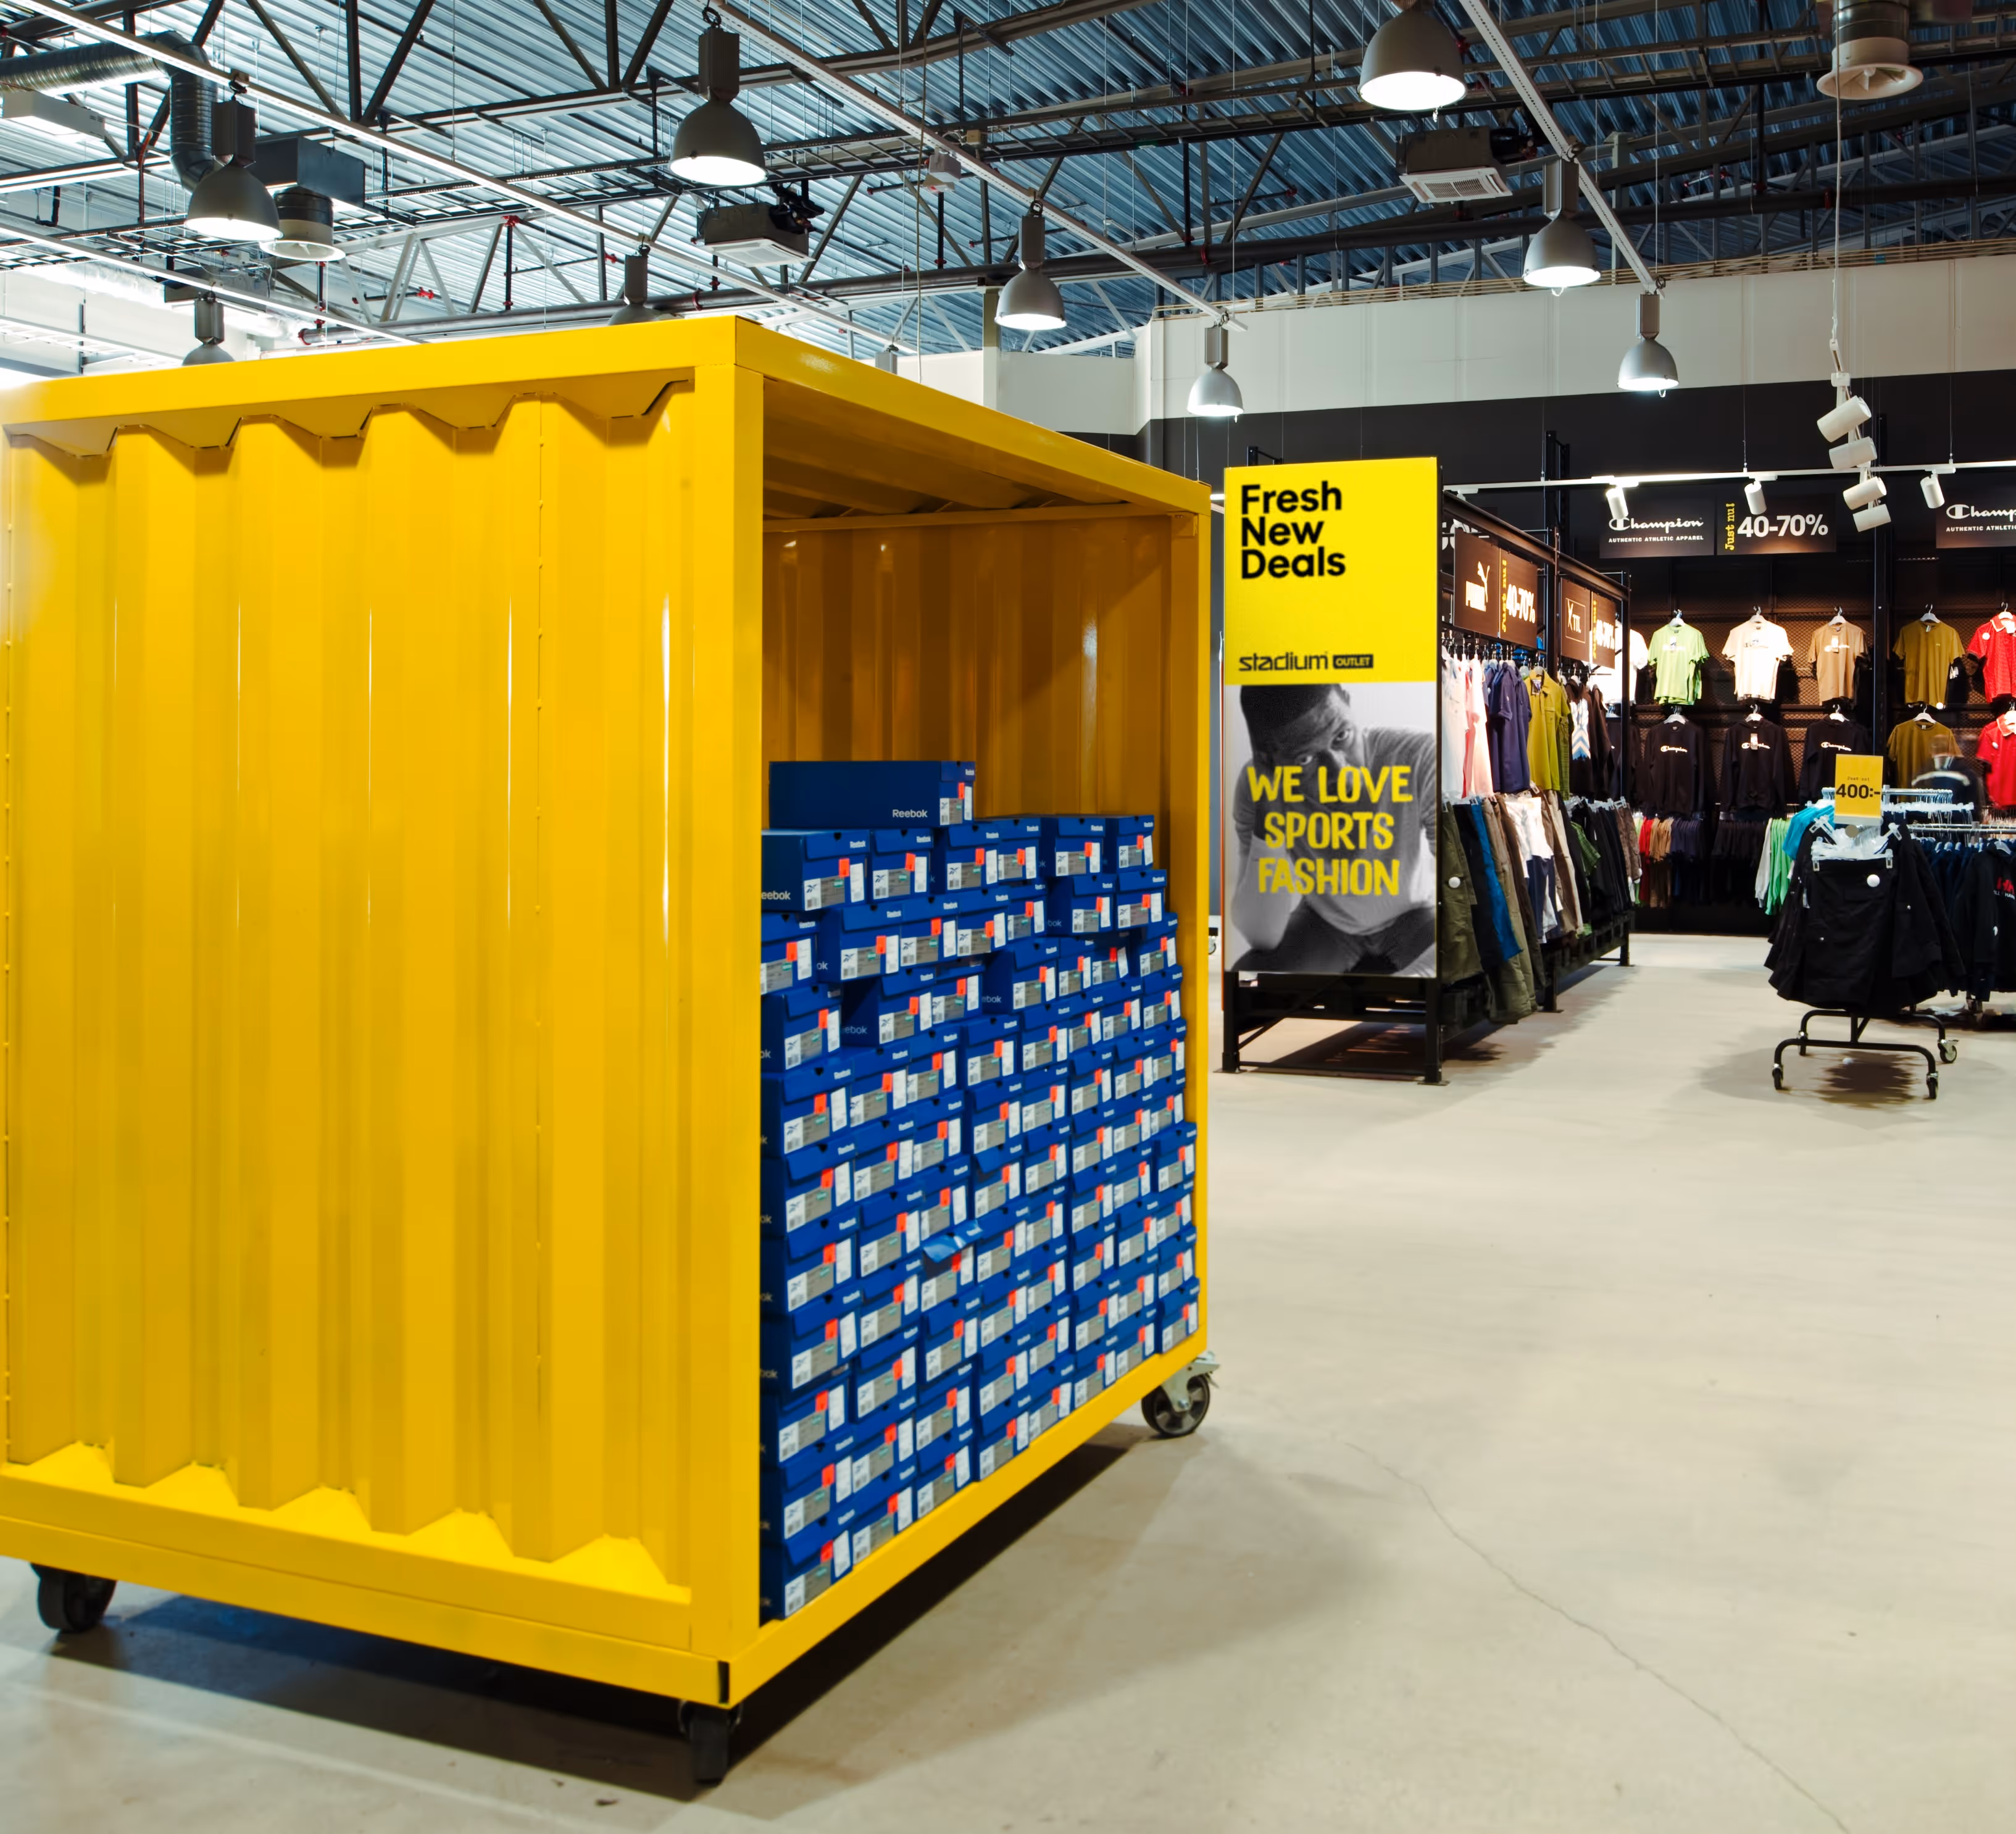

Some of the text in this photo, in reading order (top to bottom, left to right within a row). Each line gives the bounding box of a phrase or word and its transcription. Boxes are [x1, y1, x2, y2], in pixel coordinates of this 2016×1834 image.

[1241, 480, 1342, 514] Fresh
[1609, 517, 1704, 534] Champion
[1725, 502, 1735, 551] Just nu!
[1737, 514, 1829, 538] 40-70%
[1946, 504, 2016, 522] Champ
[1241, 517, 1325, 547] New
[1241, 546, 1346, 579] Deals
[1506, 583, 1536, 624] 40-70%
[1238, 652, 1372, 672] stadium OUTLET
[1246, 765, 1414, 804] WE LOVE
[1836, 783, 1881, 799] 400:-
[892, 809, 928, 819] Reebok
[1264, 811, 1394, 850] SPORTS
[1258, 857, 1401, 896] FASHION
[761, 891, 791, 901] eebok
[844, 1025, 868, 1035] ebok
